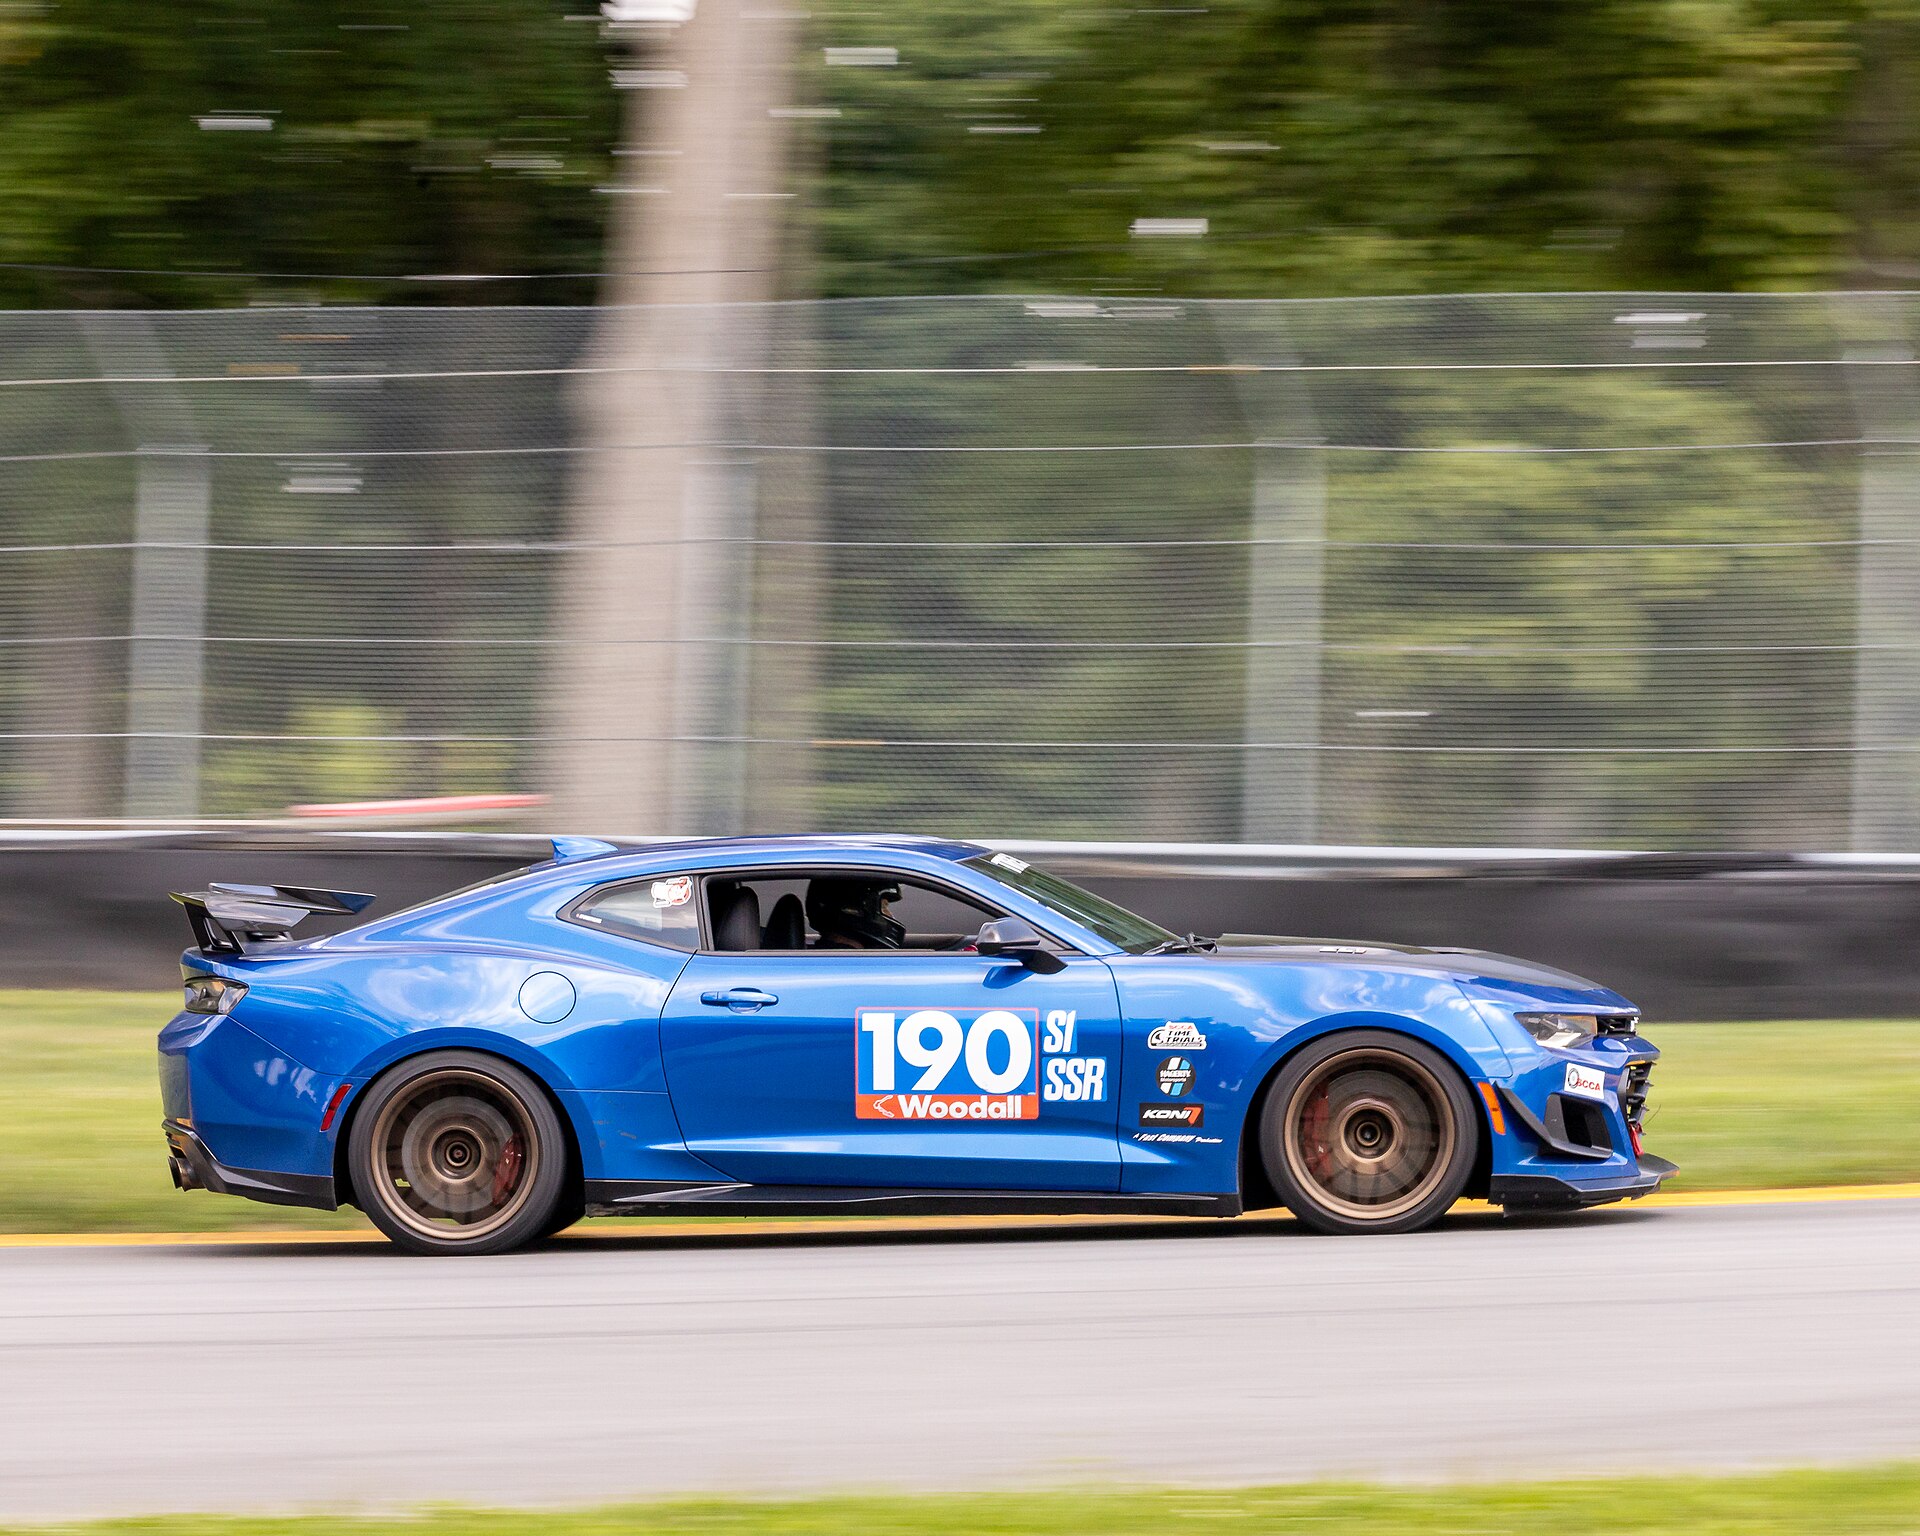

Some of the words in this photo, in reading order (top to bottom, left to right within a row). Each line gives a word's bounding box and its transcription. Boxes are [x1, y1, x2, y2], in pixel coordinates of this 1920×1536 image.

[862, 1010, 1032, 1094] 190
[1043, 1058, 1105, 1101] SSR
[1576, 1078, 1601, 1091] SCCA
[897, 1094, 1022, 1118] Woodall
[1143, 1110, 1191, 1119] KONI
[1156, 1133, 1197, 1143] Company
